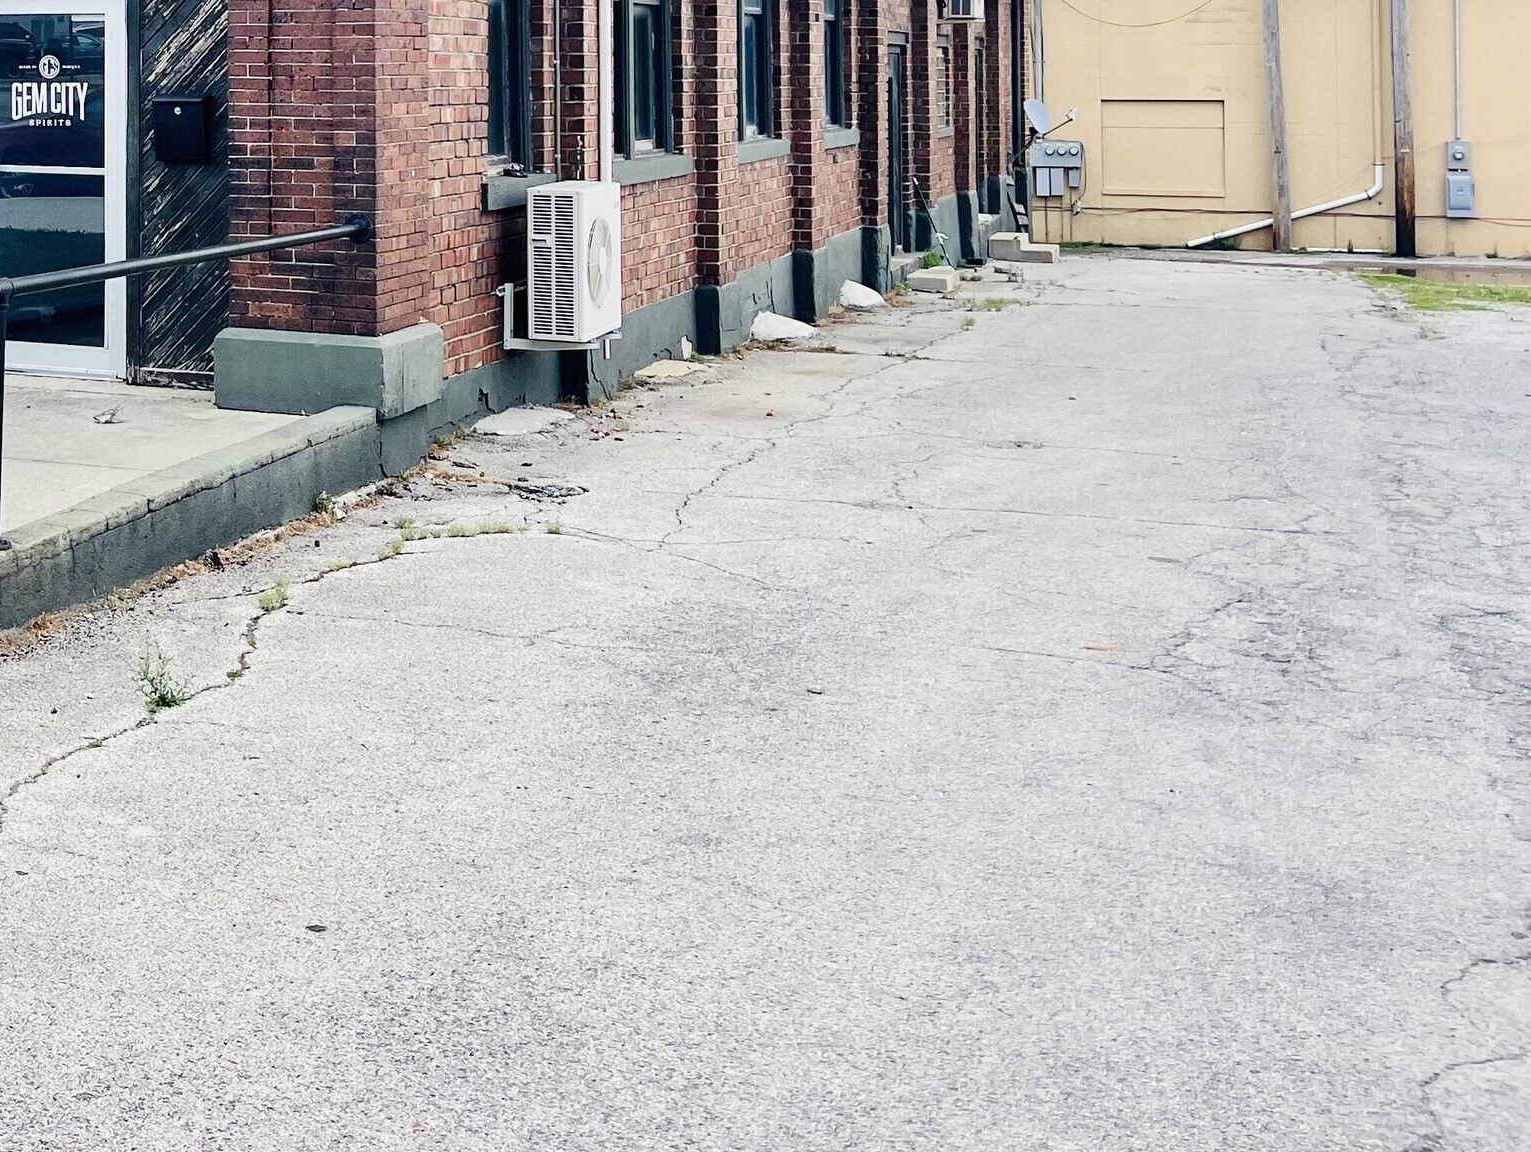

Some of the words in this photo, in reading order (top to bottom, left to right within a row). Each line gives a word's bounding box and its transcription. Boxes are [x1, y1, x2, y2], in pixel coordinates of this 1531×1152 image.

[11, 82, 48, 121] GEM
[50, 82, 88, 121] CITY
[29, 118, 72, 127] SPIRITS
